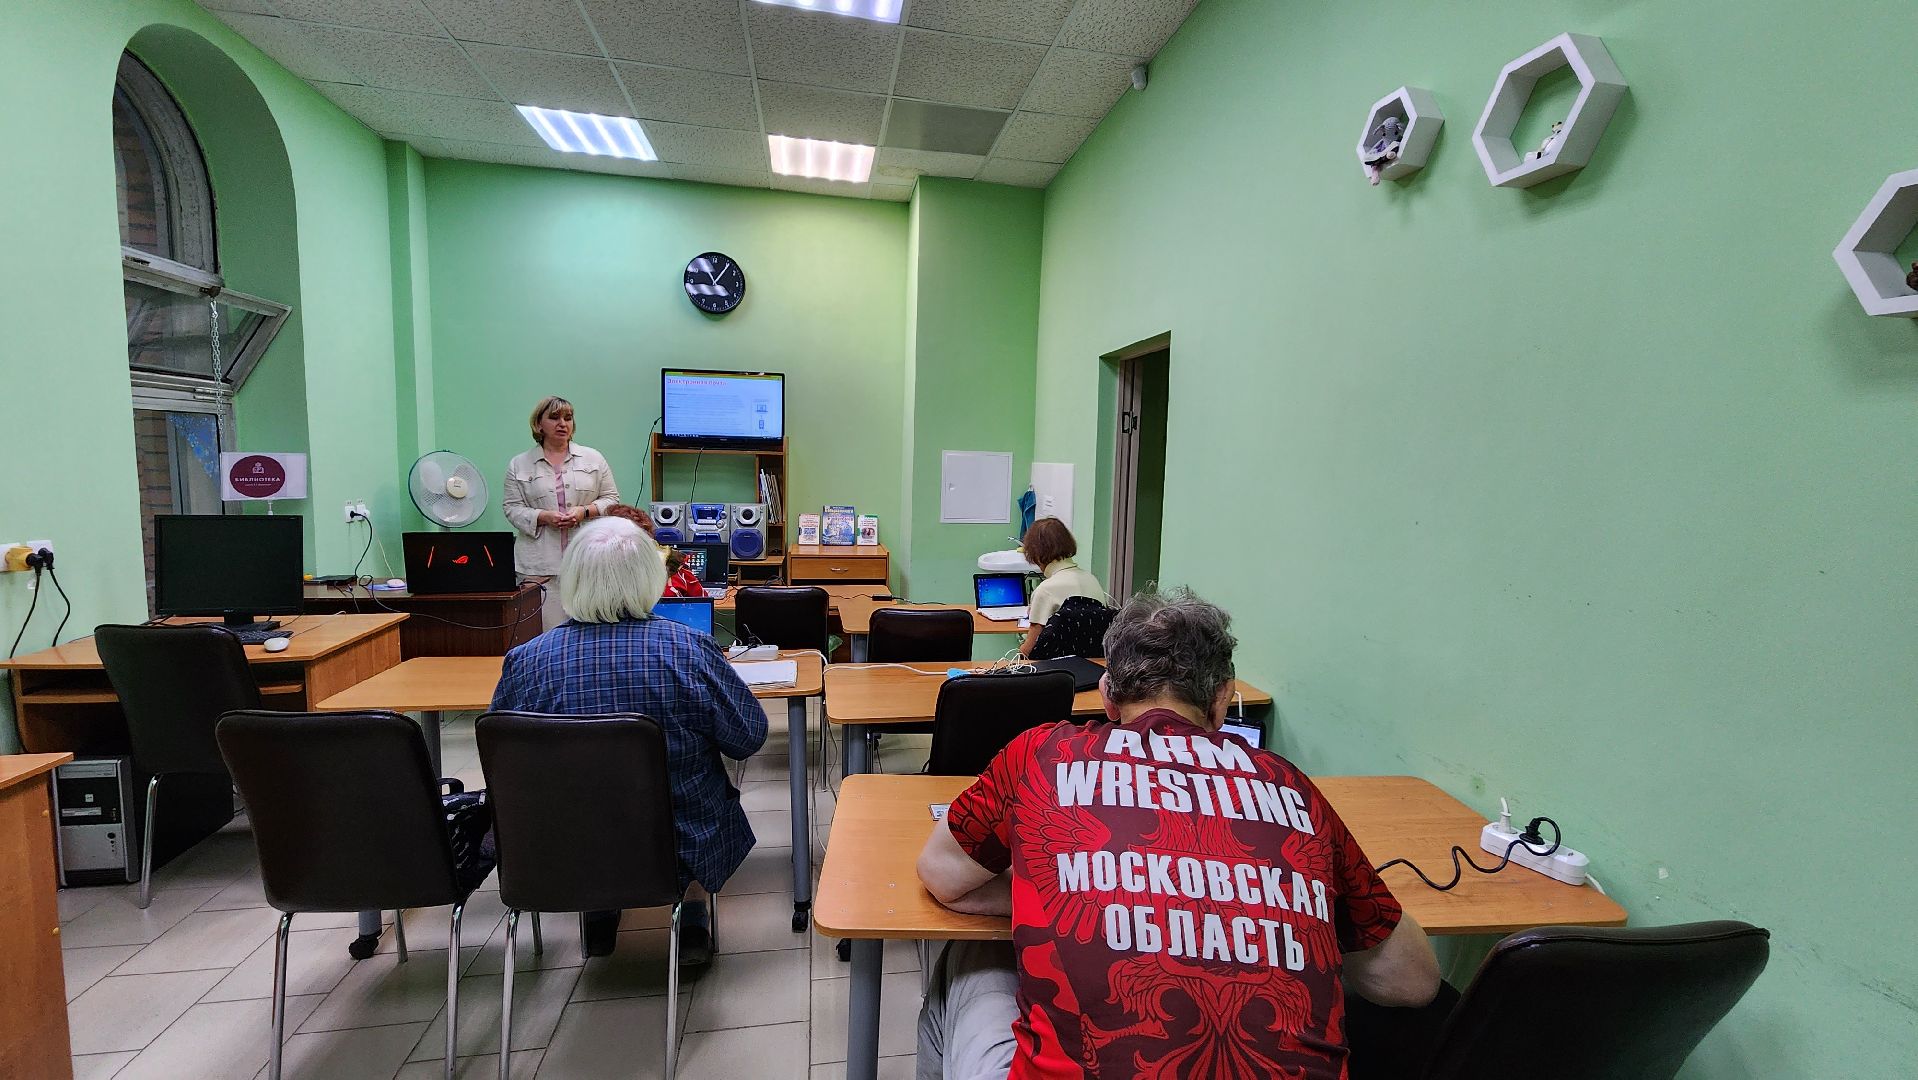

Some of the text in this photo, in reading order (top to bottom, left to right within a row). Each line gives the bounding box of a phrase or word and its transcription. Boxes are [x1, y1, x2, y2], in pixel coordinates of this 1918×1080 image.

[1104, 728, 1258, 774] ARM
[1056, 759, 1315, 836] WRESTLING
[1057, 851, 1330, 925] МОСКОВСКАЯ
[1104, 904, 1305, 972] ОБЛАСТЬ
